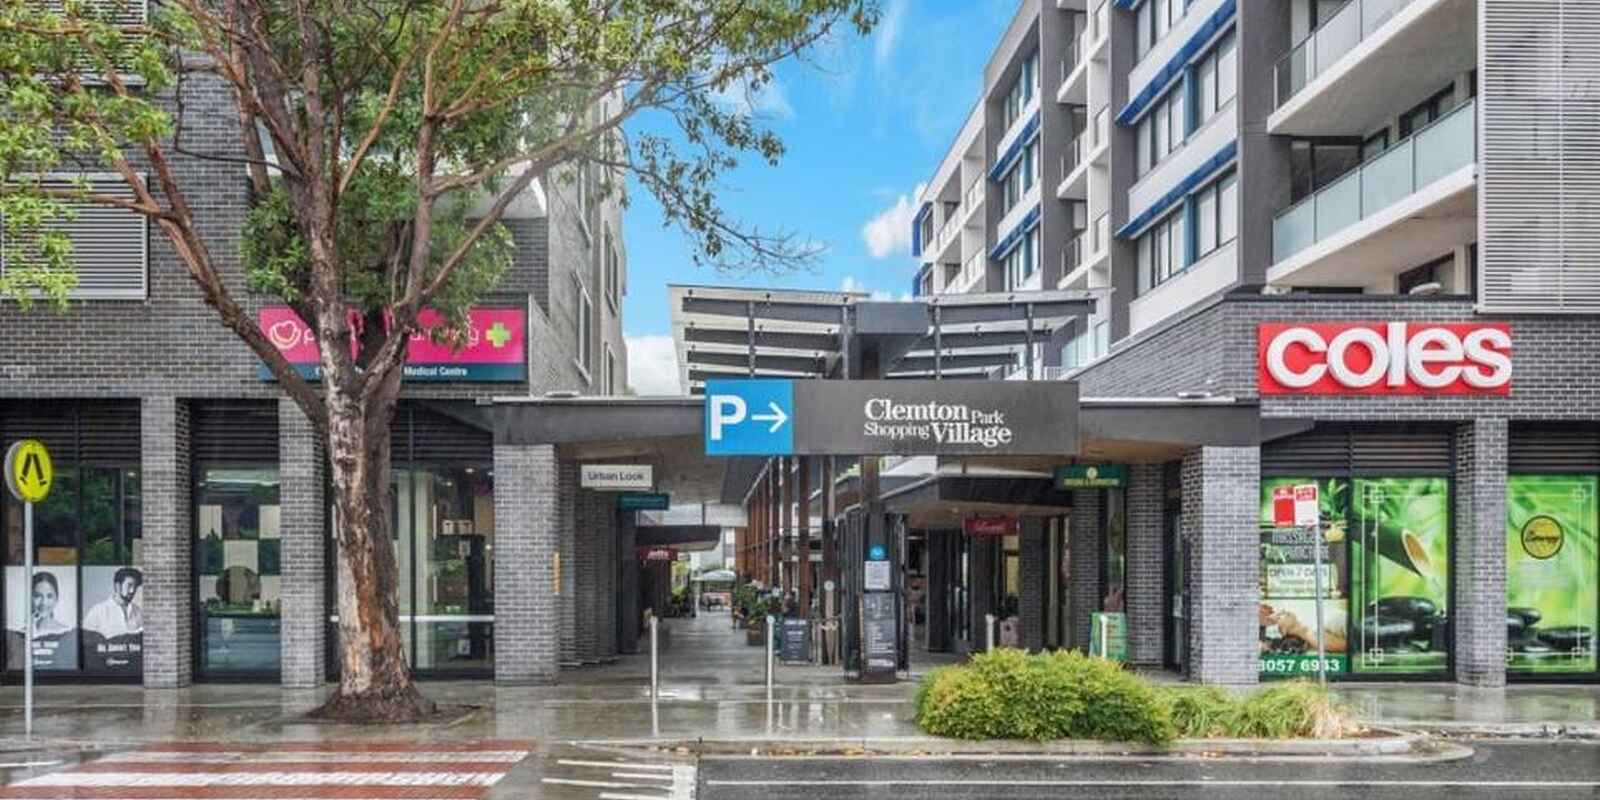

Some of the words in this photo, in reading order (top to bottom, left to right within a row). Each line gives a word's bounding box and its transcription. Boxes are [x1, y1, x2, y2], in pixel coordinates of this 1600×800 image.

[1266, 321, 1513, 388] coles
[404, 366, 437, 376] Medical
[440, 366, 468, 376] Centre
[710, 394, 747, 441] P
[864, 398, 969, 421] Clemton
[971, 409, 1005, 425] Park
[863, 421, 930, 440] Shopping
[930, 422, 1013, 447] Village
[587, 471, 617, 481] Urban
[619, 471, 644, 481] Look
